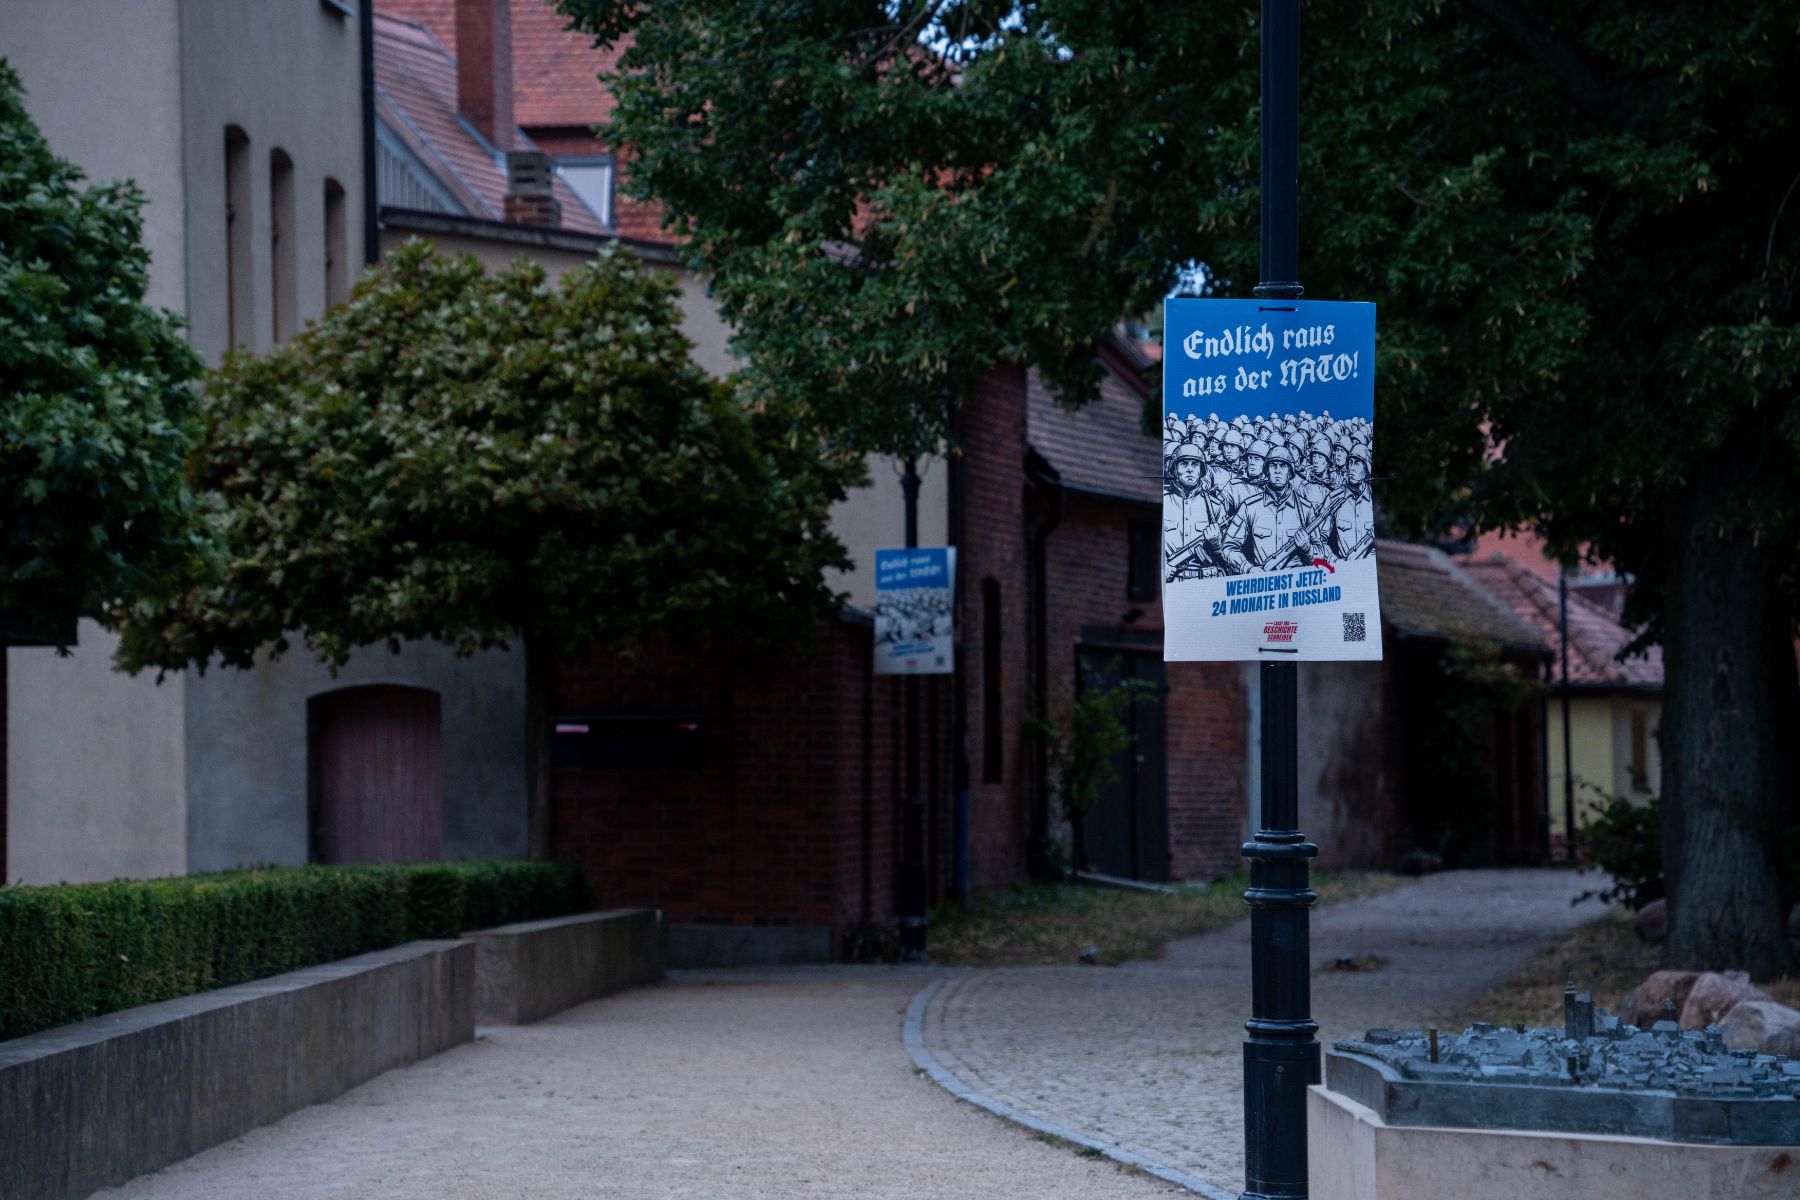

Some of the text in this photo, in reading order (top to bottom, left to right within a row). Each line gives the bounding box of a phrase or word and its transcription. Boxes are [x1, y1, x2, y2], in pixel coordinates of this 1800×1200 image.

[1183, 323, 1336, 360] Endlich raus
[1183, 350, 1359, 398] aus der NATO!
[1226, 569, 1327, 596] WEHRDIENST JETZT:
[1211, 586, 1341, 616] 24 MONATE IN RUSSLAND
